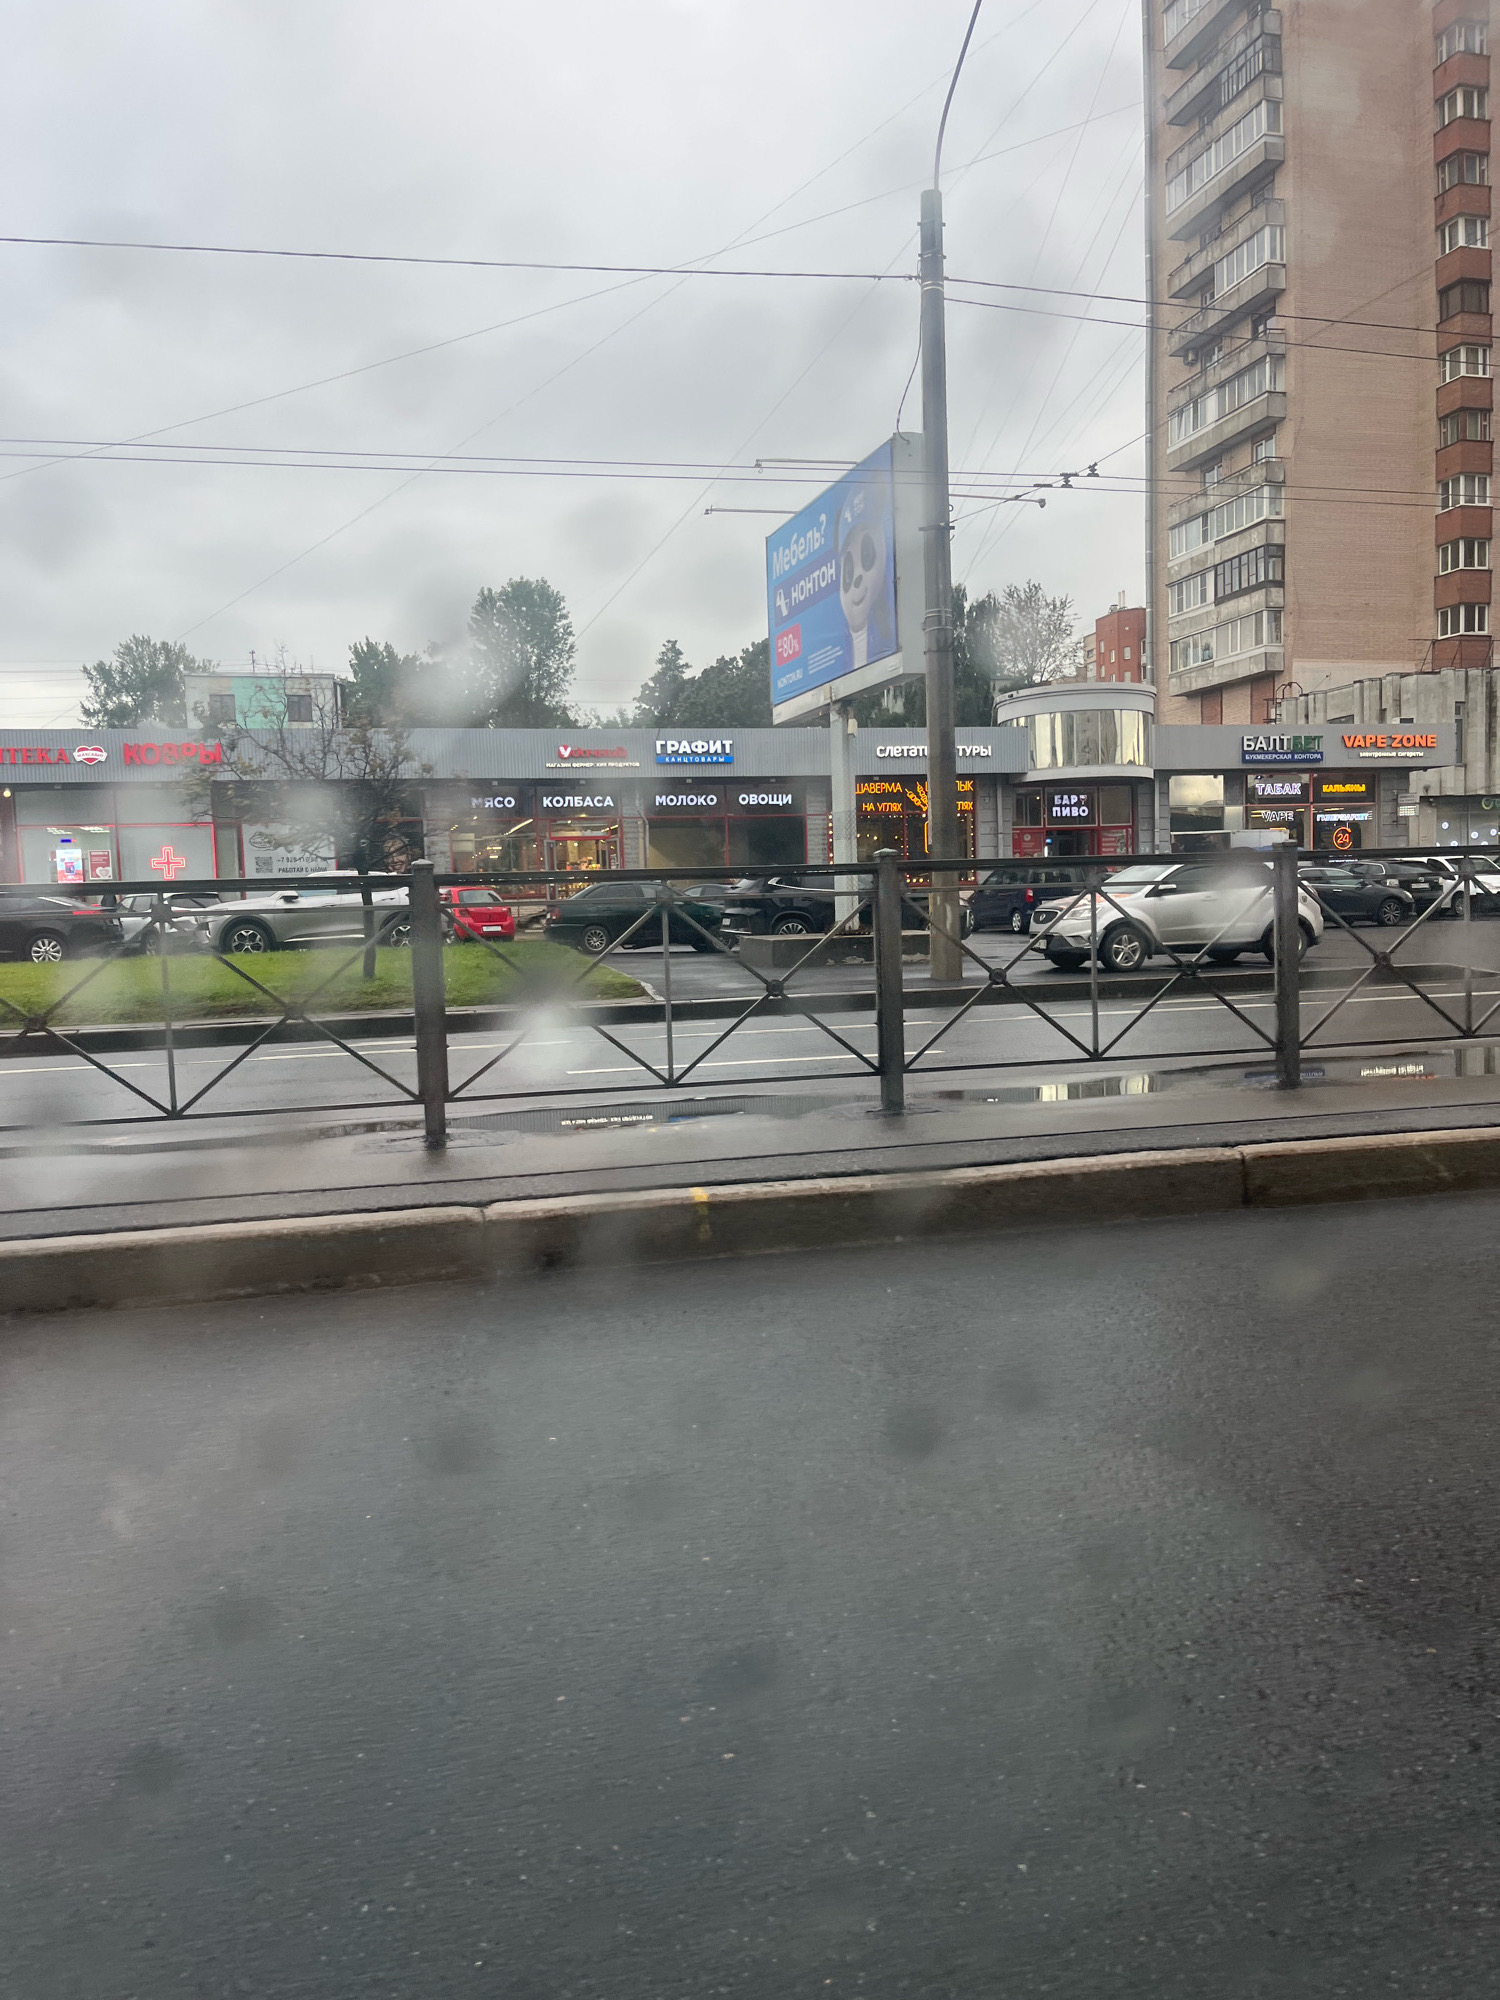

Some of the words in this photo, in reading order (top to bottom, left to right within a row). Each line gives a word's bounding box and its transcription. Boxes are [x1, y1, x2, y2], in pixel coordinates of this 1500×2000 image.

[773, 513, 827, 580] Мебель?
[791, 560, 836, 606] НОНТОН
[655, 740, 733, 754] ГРАФИТ
[1342, 735, 1387, 748] VAPE
[1391, 735, 1437, 748] ZONE
[123, 742, 222, 766] КОВРЫ
[957, 745, 992, 757] ТУРЫ
[1255, 783, 1302, 795] ТАБАК
[1322, 784, 1366, 793] КАЛЬЯНЫ
[542, 795, 614, 808] КОЛБАСА
[655, 794, 717, 806] МОЛОКО
[738, 793, 792, 806] ОВОЩИ
[1054, 795, 1078, 805] БАР
[862, 802, 875, 812] НА
[876, 802, 902, 812] УГЛЯХ
[1052, 806, 1089, 817] ПИВО
[1336, 833, 1350, 844] 24
